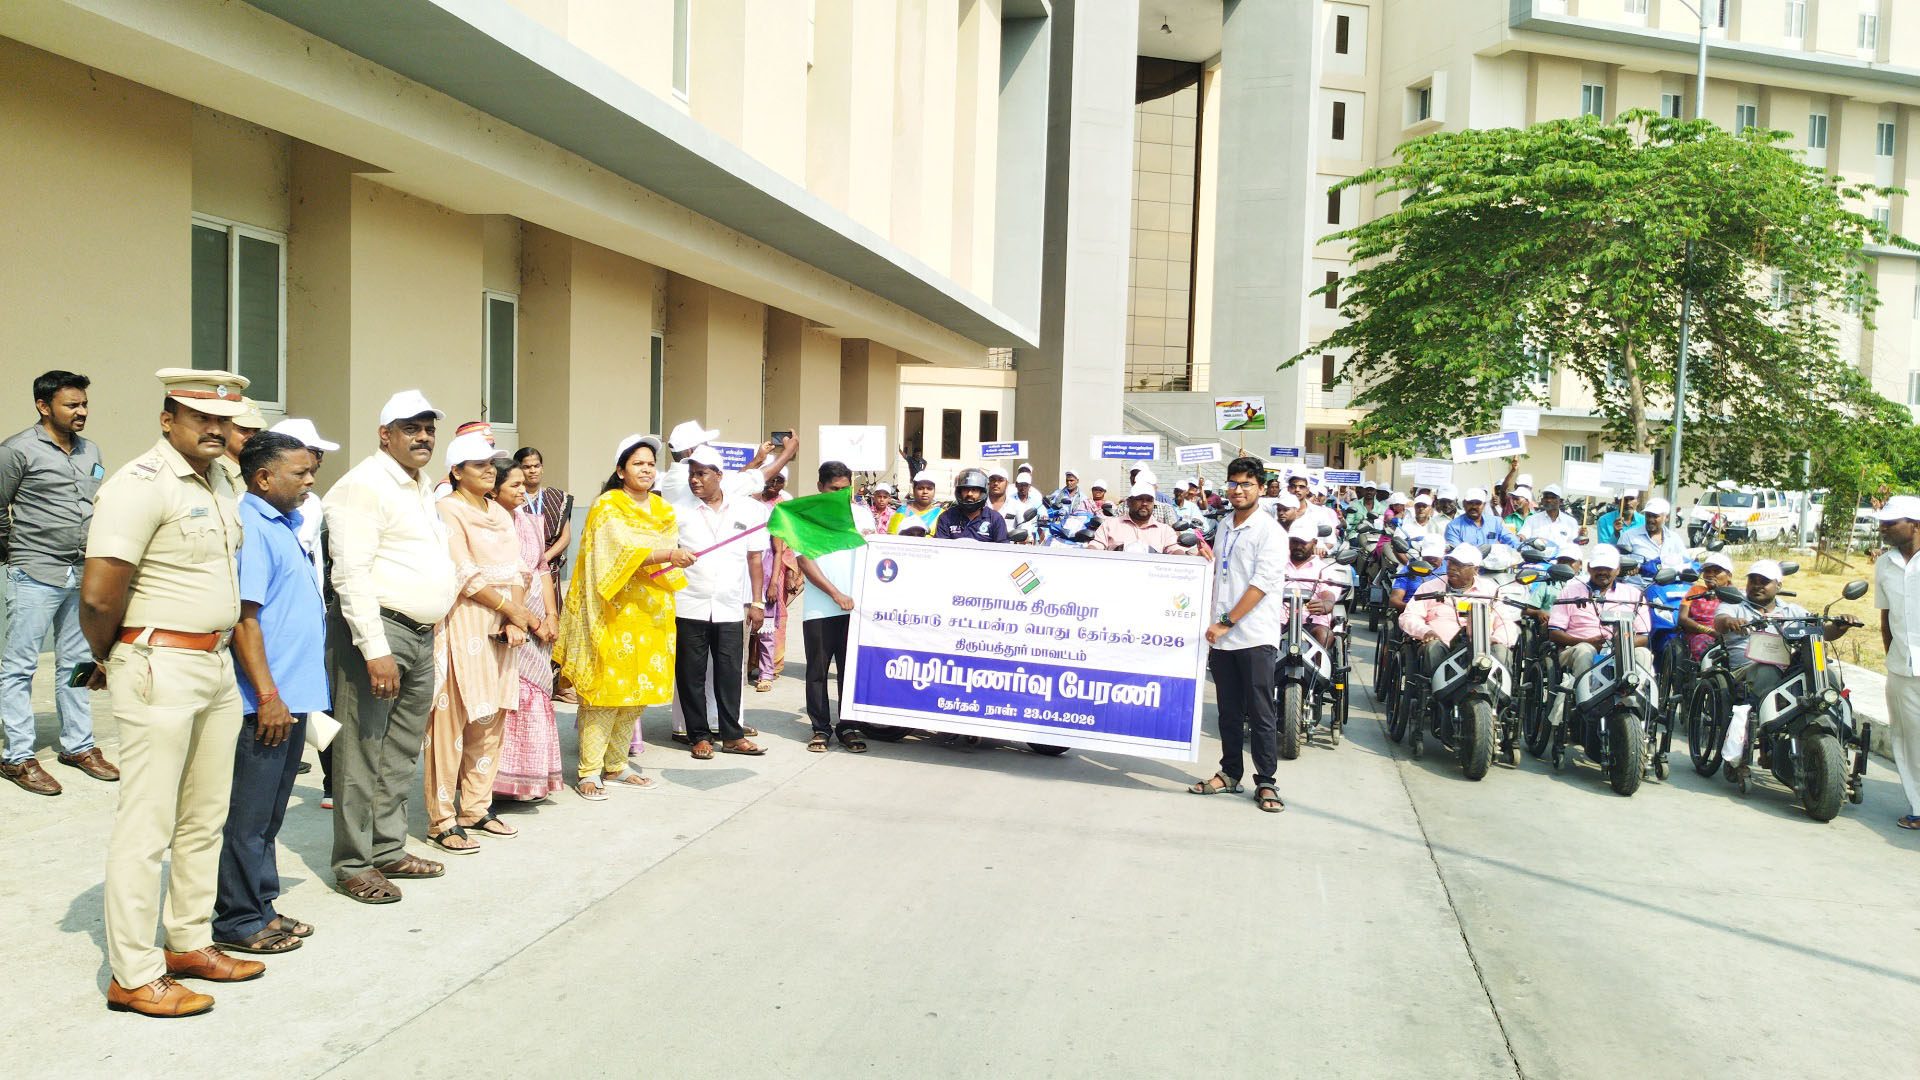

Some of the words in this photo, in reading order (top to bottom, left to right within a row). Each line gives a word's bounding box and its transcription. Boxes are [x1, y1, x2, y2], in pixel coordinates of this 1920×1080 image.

[952, 594, 1028, 613] ஜனநாயக
[1031, 599, 1099, 621] திருவிழா
[1164, 610, 1197, 618] SVEEP
[872, 609, 942, 627] தமிழ்நாடு
[948, 617, 1019, 634] சட்டமன்ற
[1025, 622, 1070, 640] பொது
[1077, 626, 1185, 648] தேர்தல்-2026
[955, 638, 1028, 657] திருப்பத்தூர்
[1031, 645, 1087, 662] மாவட்டம்
[885, 655, 1052, 702] விழிப்புணர்வு
[1058, 671, 1161, 708] பேரணி
[937, 697, 980, 712] தேர்தல்
[984, 703, 1017, 717] நாள்:
[1023, 707, 1095, 726] 23.04.2026
